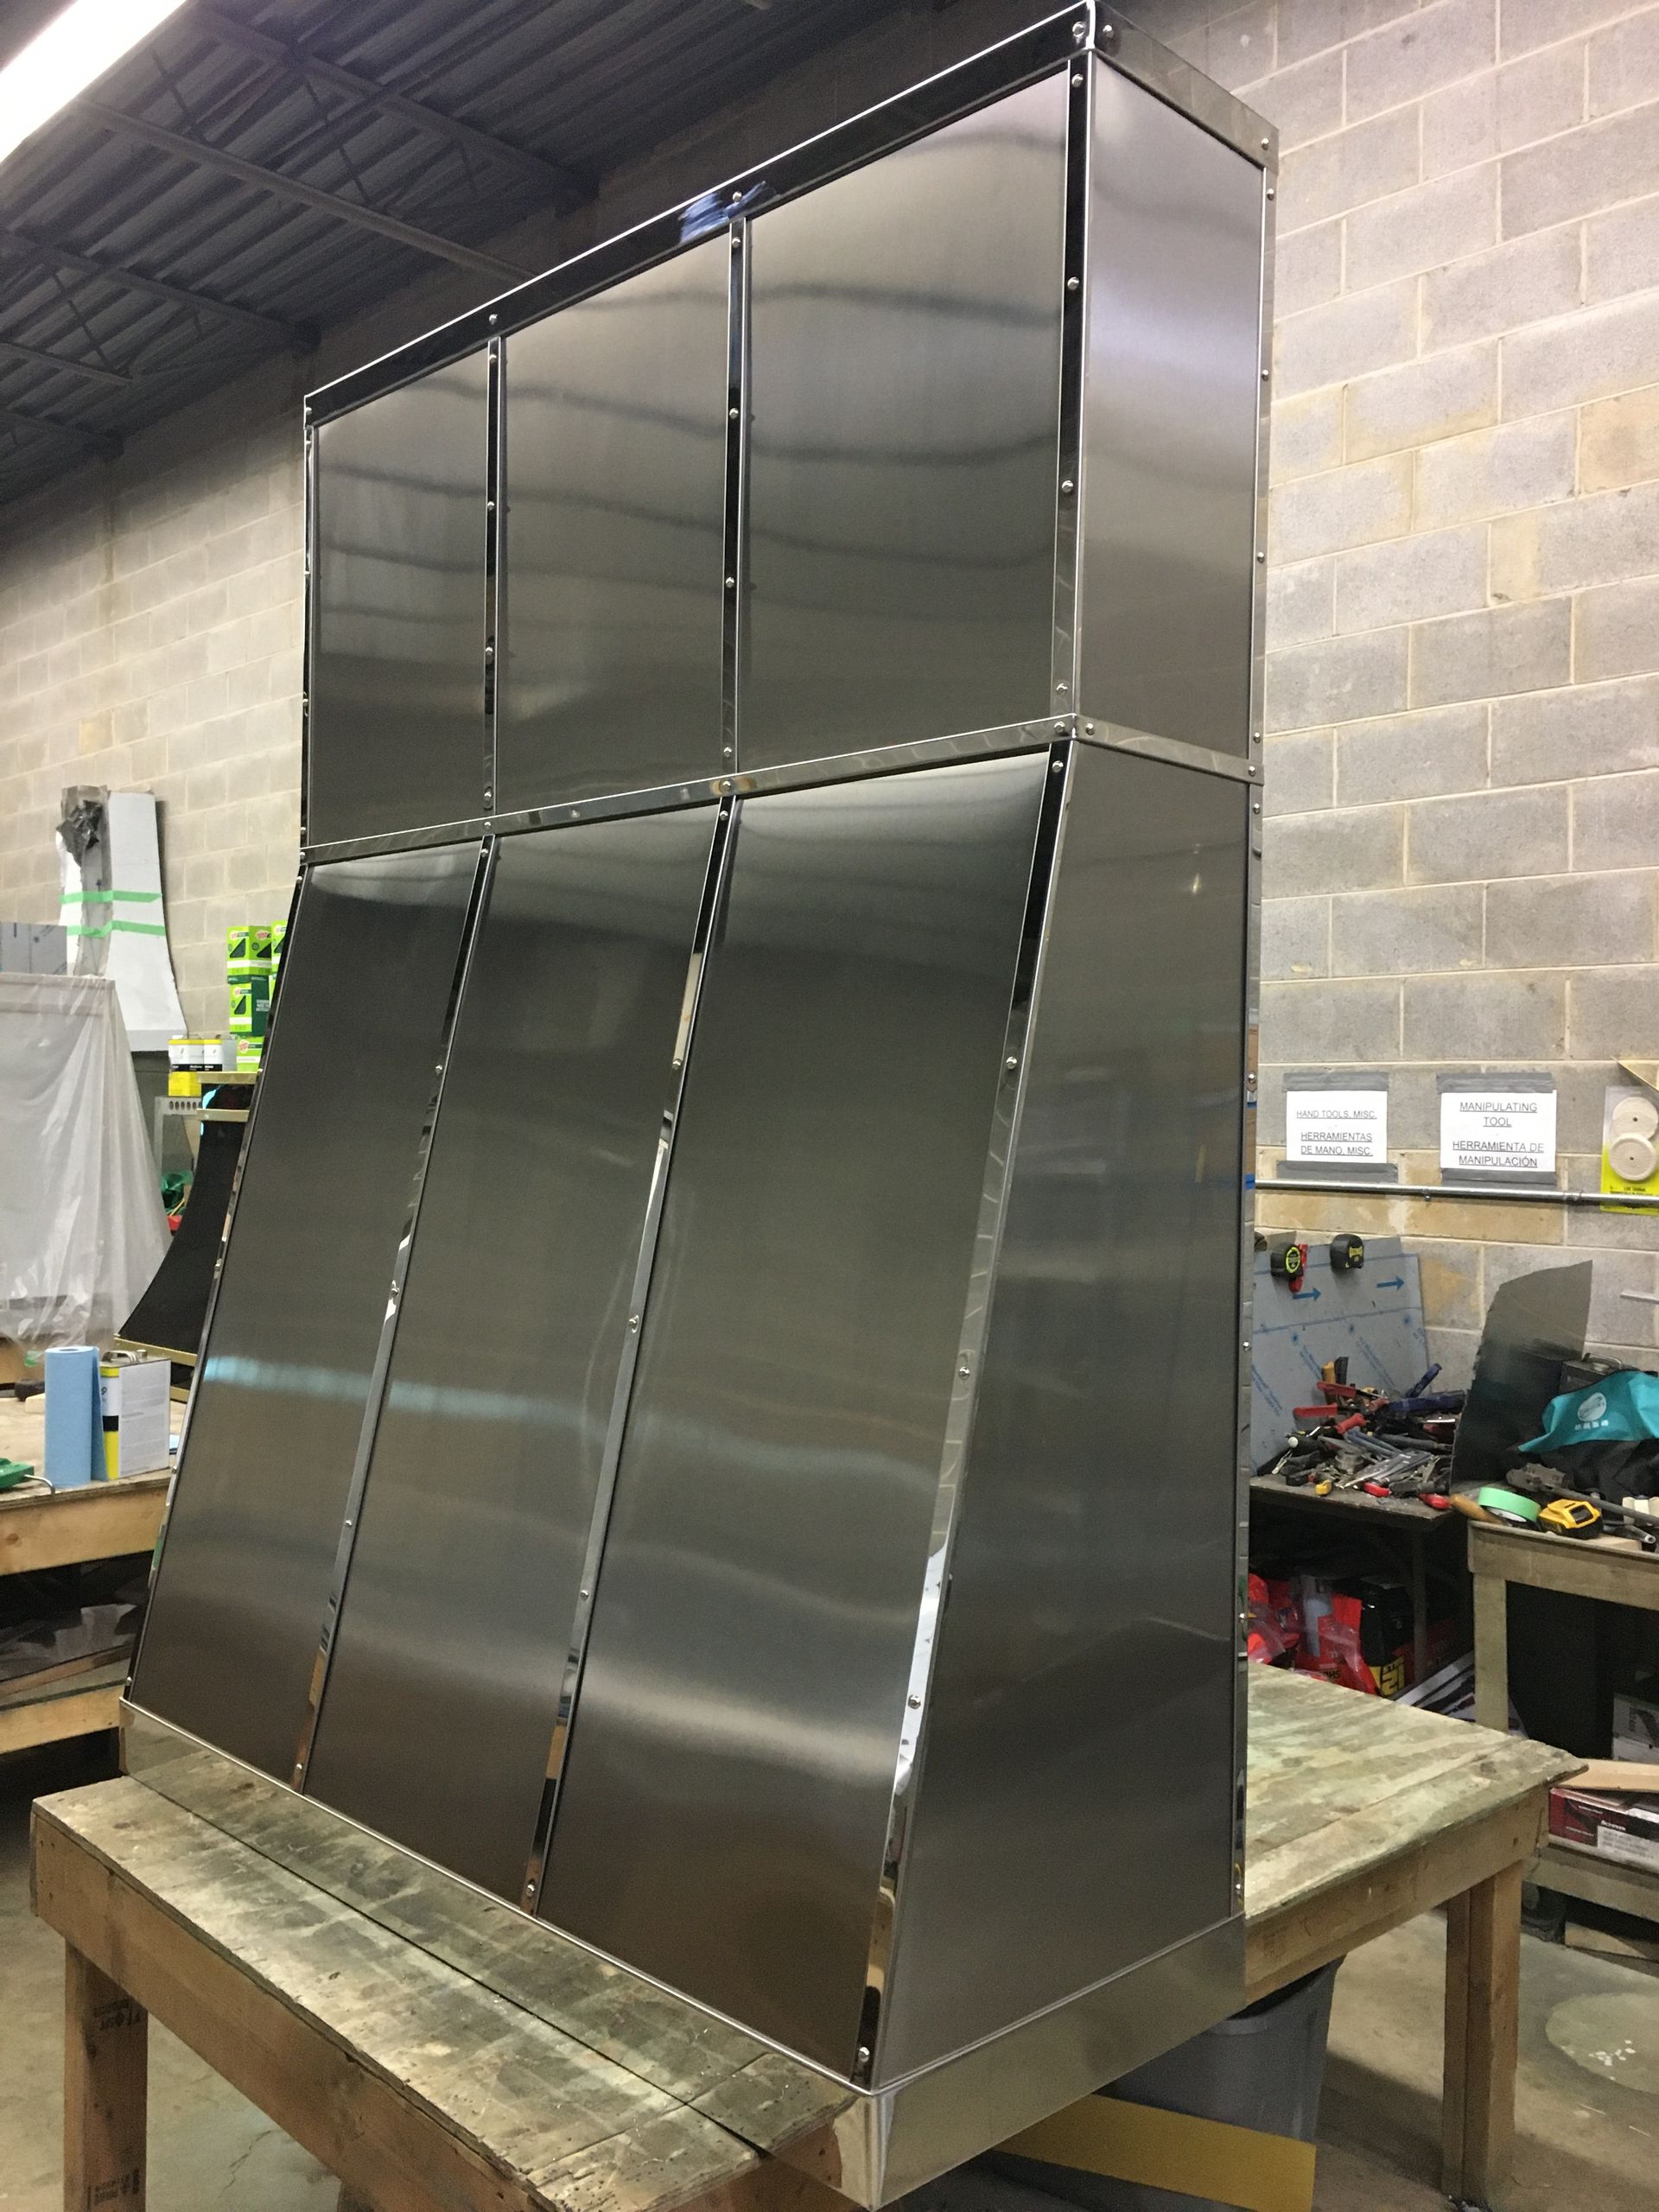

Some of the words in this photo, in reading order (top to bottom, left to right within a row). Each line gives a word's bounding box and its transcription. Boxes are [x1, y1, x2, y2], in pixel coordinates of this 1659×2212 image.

[1459, 1102, 1538, 1113] MANIPULATING
[1484, 1116, 1511, 1127] TOOL
[1300, 1132, 1372, 1142] HERRAMIENTAS
[1300, 1146, 1313, 1154] DE
[1452, 1141, 1527, 1152] HERRAMIENTA
[1529, 1143, 1544, 1153] DE
[1459, 1155, 1538, 1167] MANIPULACIÓN
